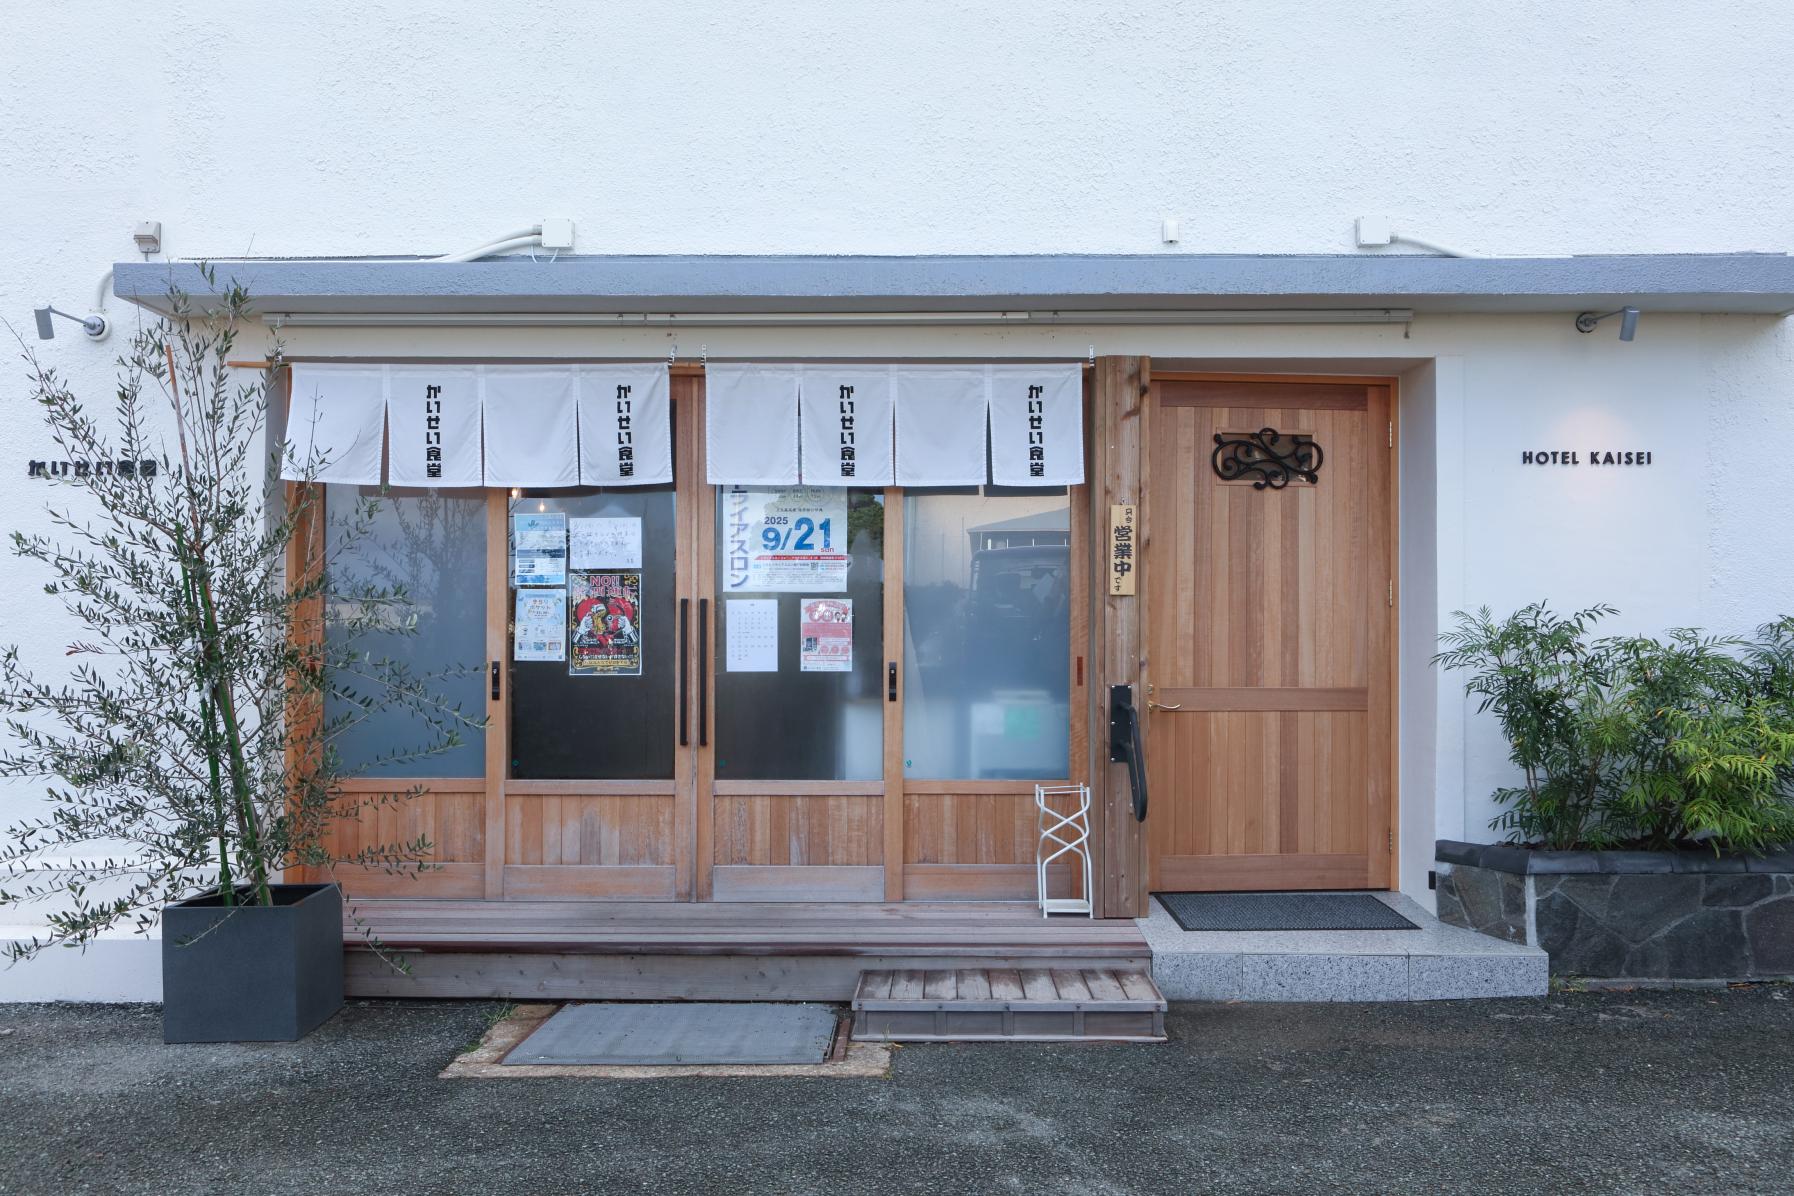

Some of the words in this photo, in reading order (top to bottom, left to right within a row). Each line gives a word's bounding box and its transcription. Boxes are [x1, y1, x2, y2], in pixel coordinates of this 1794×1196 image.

[426, 384, 442, 478] かいせい食堂
[616, 384, 634, 477] かいせい食堂
[839, 384, 856, 477] かいせい食堂
[1028, 384, 1045, 477] かいせい食堂
[1522, 451, 1580, 465] HOTEL
[1590, 451, 1652, 465] KAISEI
[730, 485, 749, 588] ライアスロン
[761, 517, 831, 551] 9/21
[764, 516, 789, 525] 2025
[590, 575, 620, 587] NO!!
